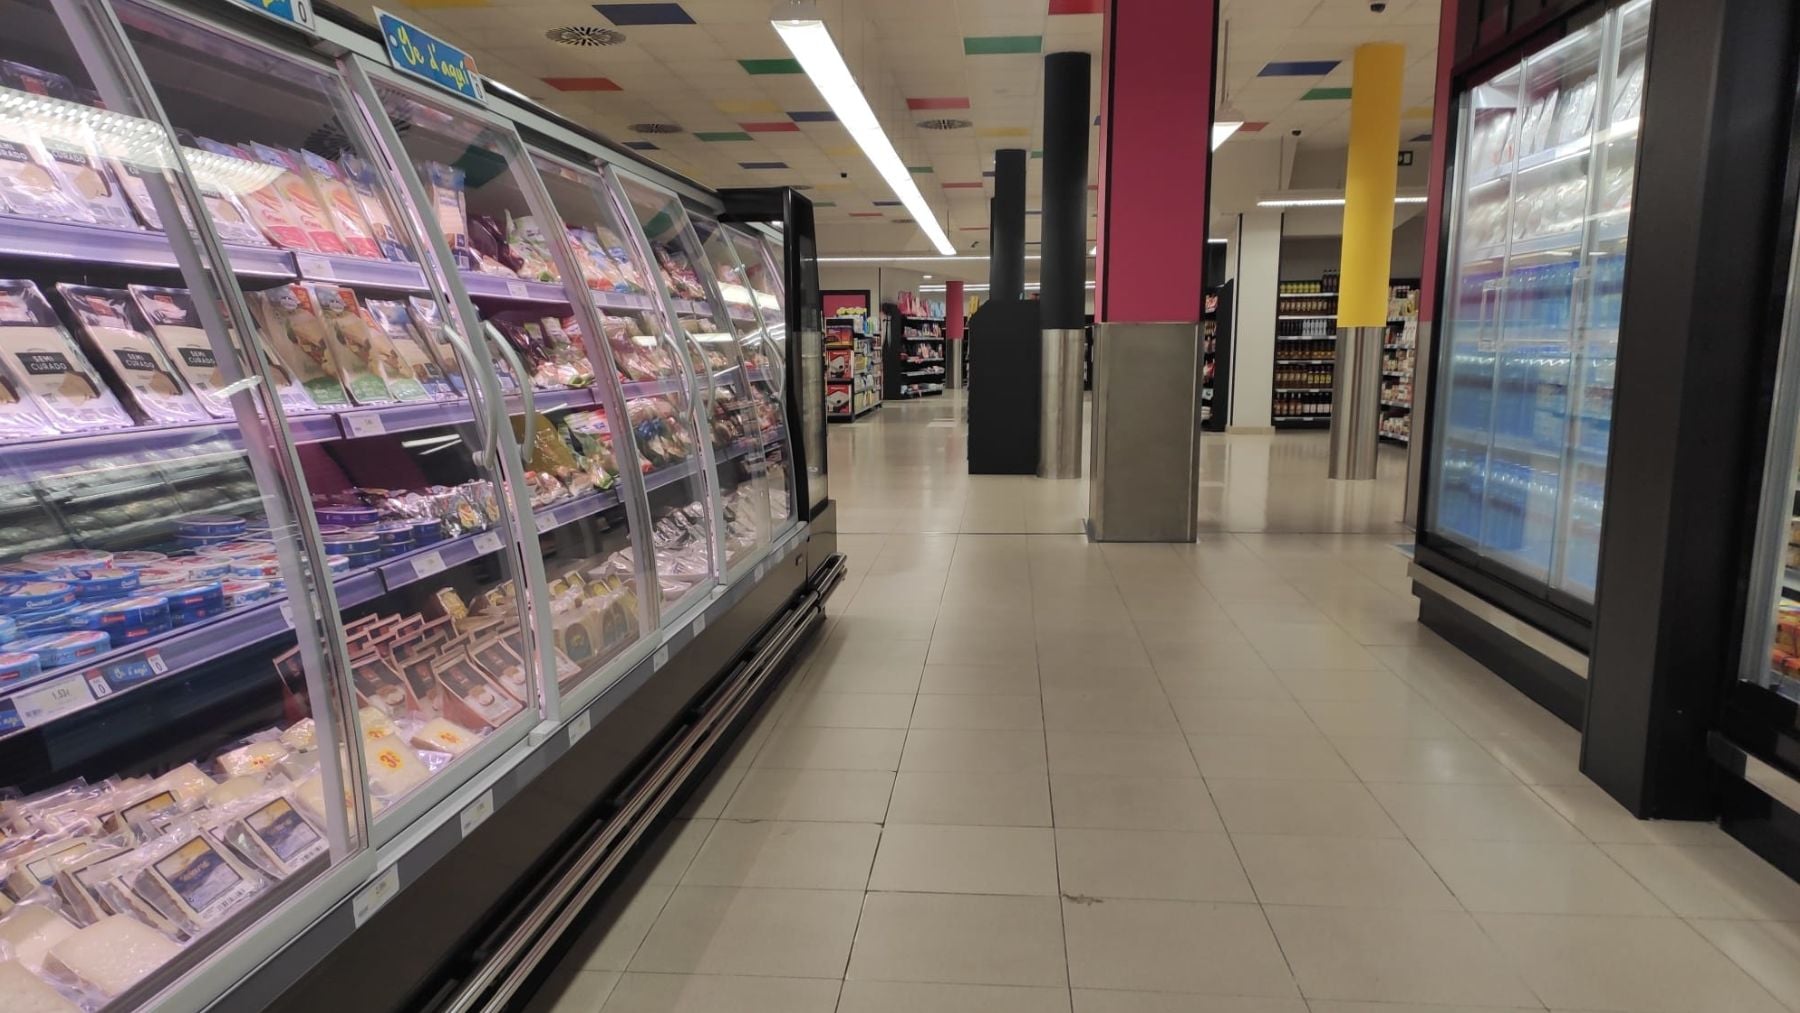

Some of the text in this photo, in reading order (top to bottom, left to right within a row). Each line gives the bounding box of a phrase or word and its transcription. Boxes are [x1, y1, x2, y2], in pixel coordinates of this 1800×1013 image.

[127, 353, 145, 361] SEMI
[30, 362, 68, 371] CURADO
[124, 359, 156, 369] CURADO
